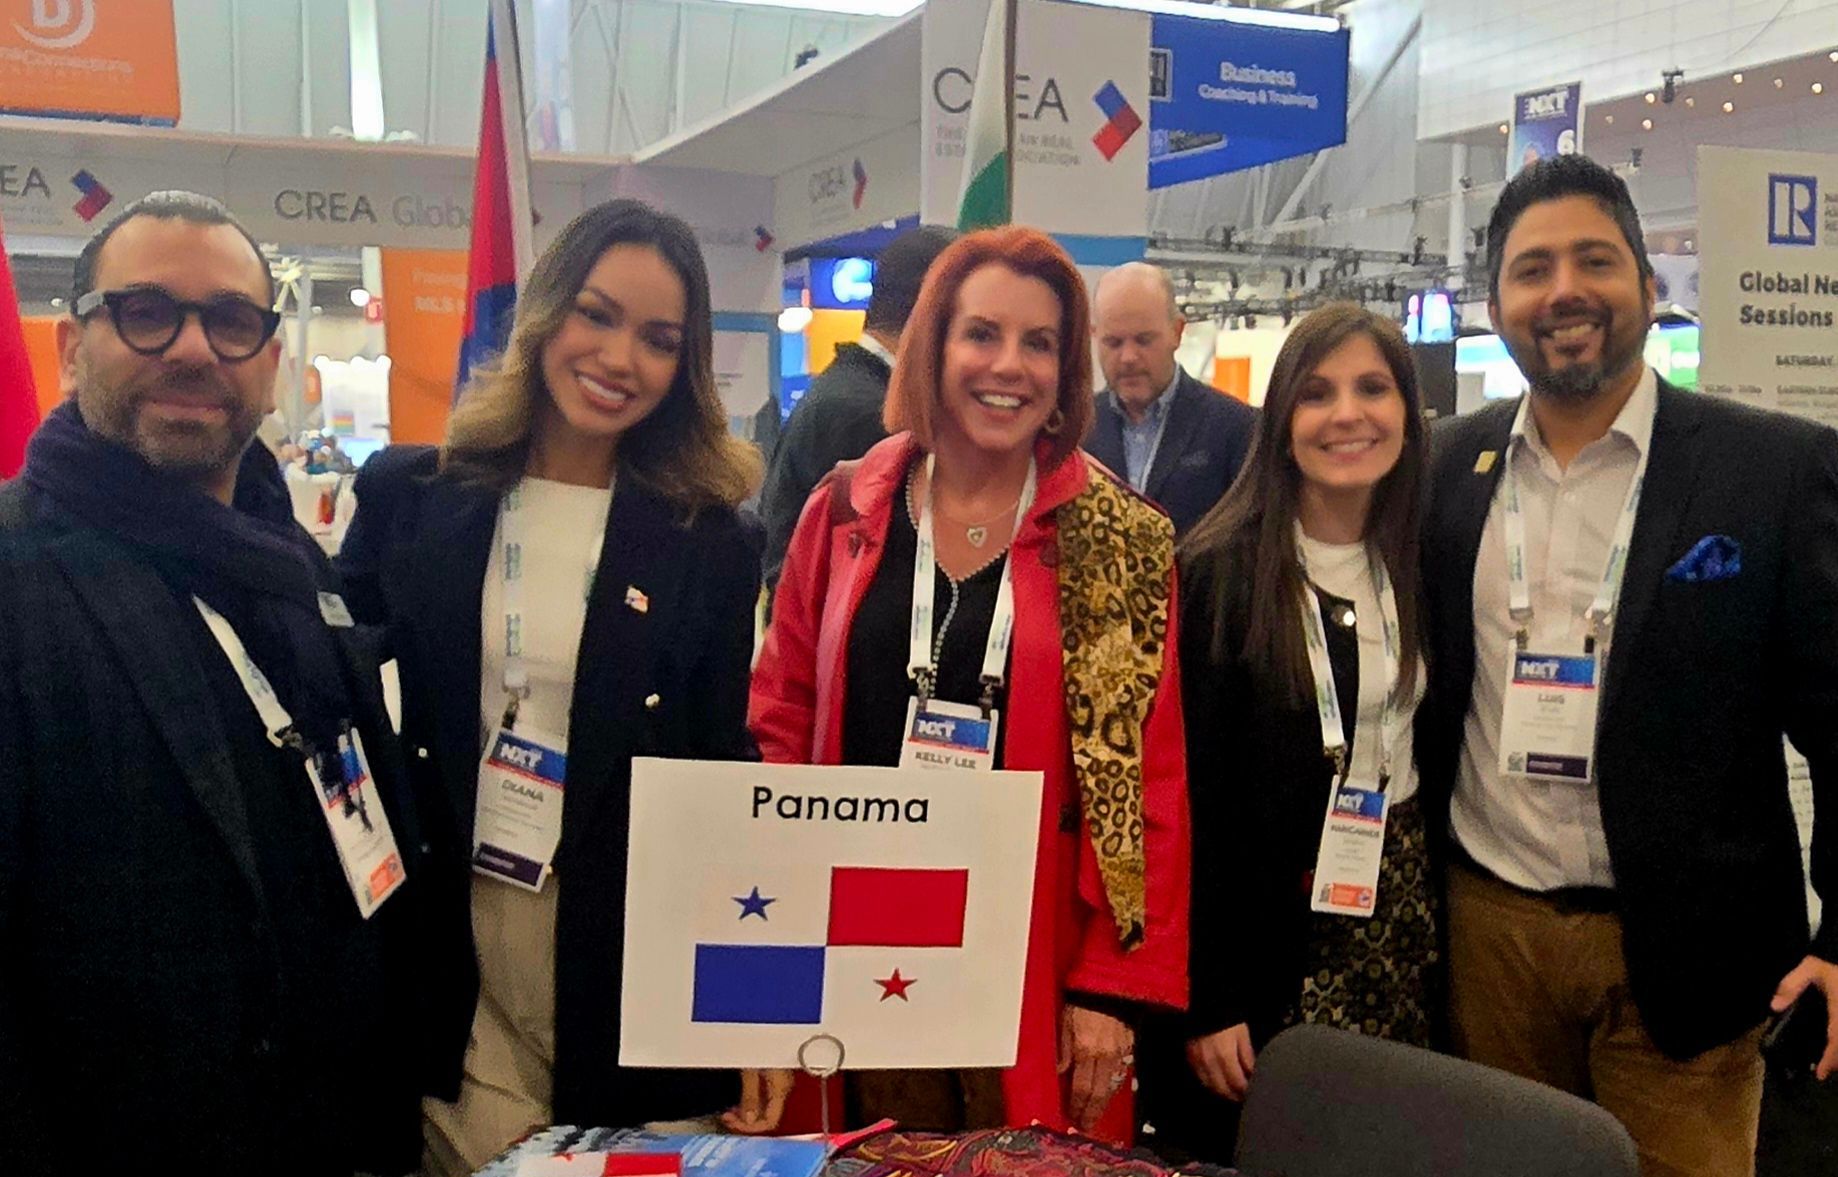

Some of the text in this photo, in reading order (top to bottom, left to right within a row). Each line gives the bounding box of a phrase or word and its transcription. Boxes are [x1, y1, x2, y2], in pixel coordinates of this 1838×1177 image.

[1220, 62, 1295, 88] Business
[1200, 84, 1257, 105] Coaching
[1268, 90, 1319, 110] Training
[274, 189, 377, 224] CREA
[1739, 271, 1810, 294] Global
[1739, 304, 1833, 327] Sessions
[915, 751, 952, 764] KELLY
[955, 758, 976, 769] LEE
[502, 779, 544, 802] DIANA
[752, 786, 929, 823] Panama
